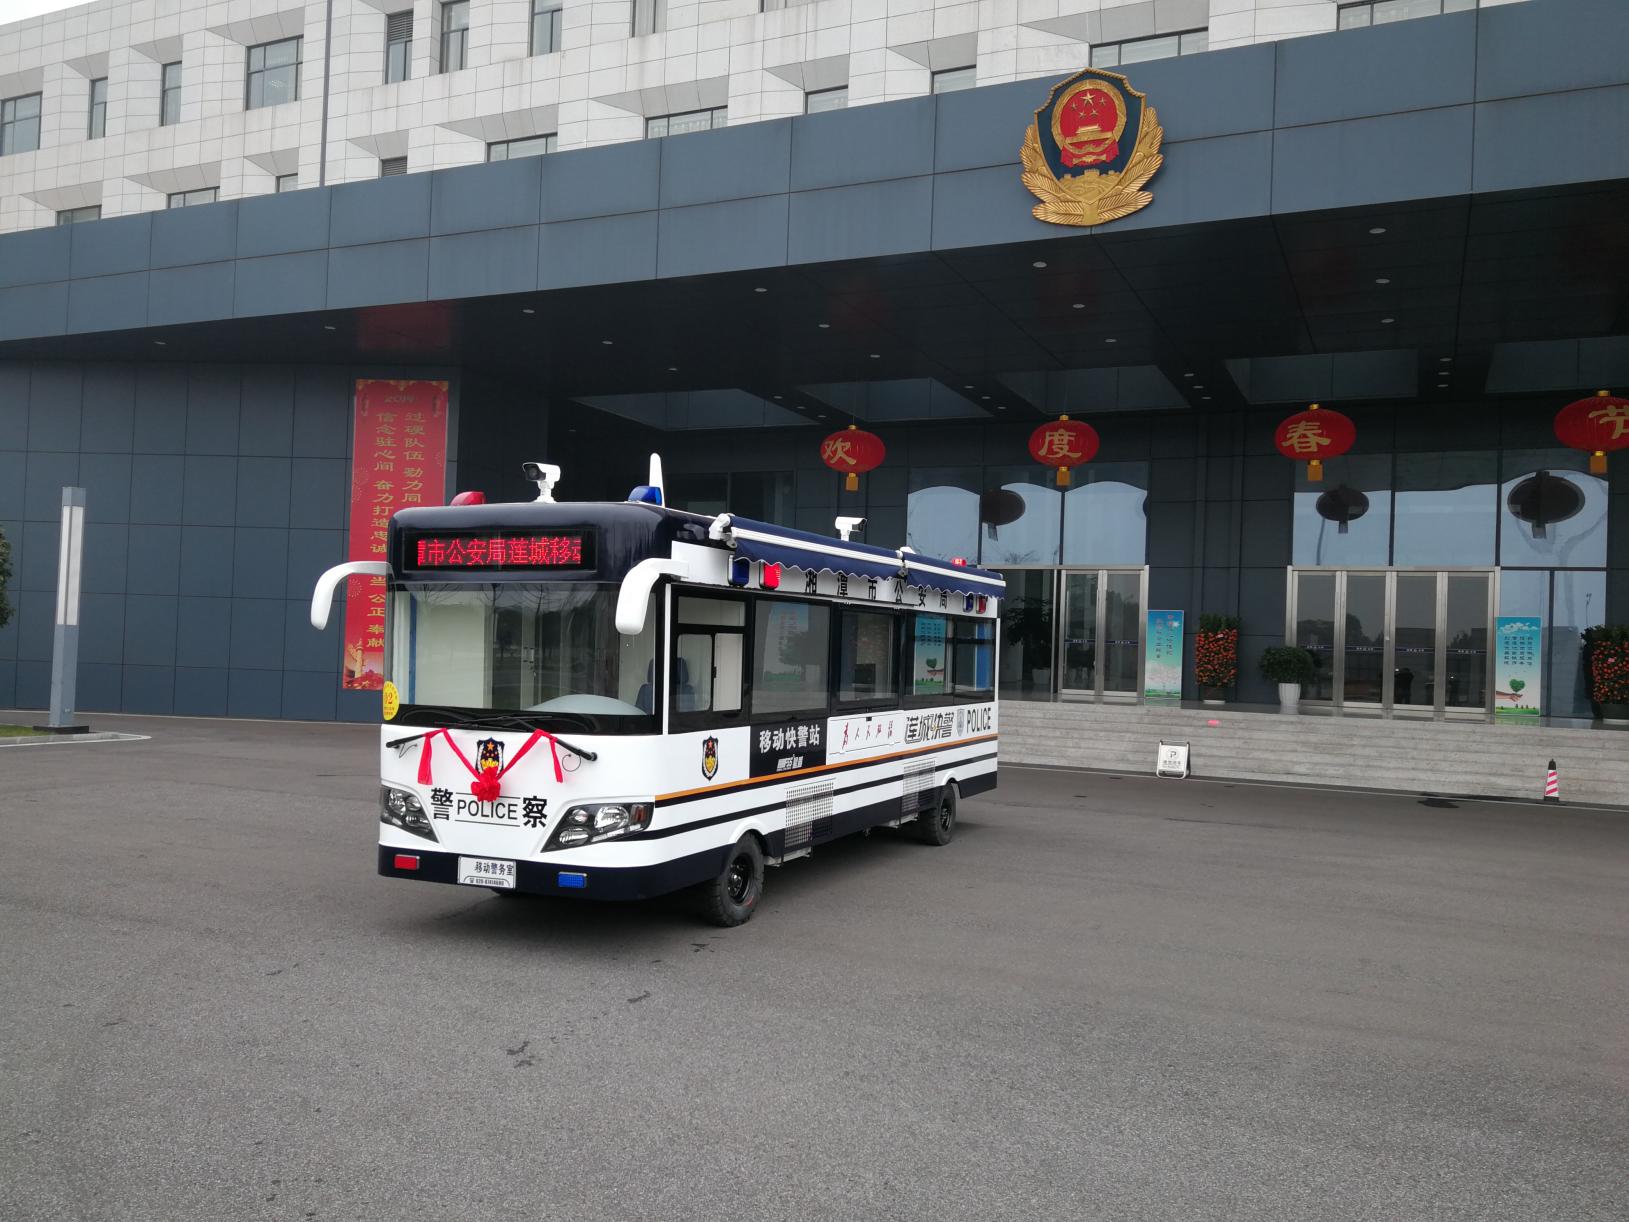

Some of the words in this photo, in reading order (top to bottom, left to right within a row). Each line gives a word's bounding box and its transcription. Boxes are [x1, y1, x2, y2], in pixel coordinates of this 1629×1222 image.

[374, 412, 397, 472] 信念驻心间
[403, 411, 425, 461] 过硬队伍
[822, 438, 857, 465] 欢
[1038, 428, 1082, 458] 度
[1281, 420, 1332, 453] 春
[367, 593, 385, 617] 公正
[759, 724, 820, 754] 移动快警站
[904, 711, 955, 744] 莲城快警
[966, 707, 992, 734] POLICE
[430, 787, 454, 821] 警
[457, 799, 518, 820] POLICE
[522, 795, 548, 829] 察
[474, 861, 514, 876] 移动警务室
